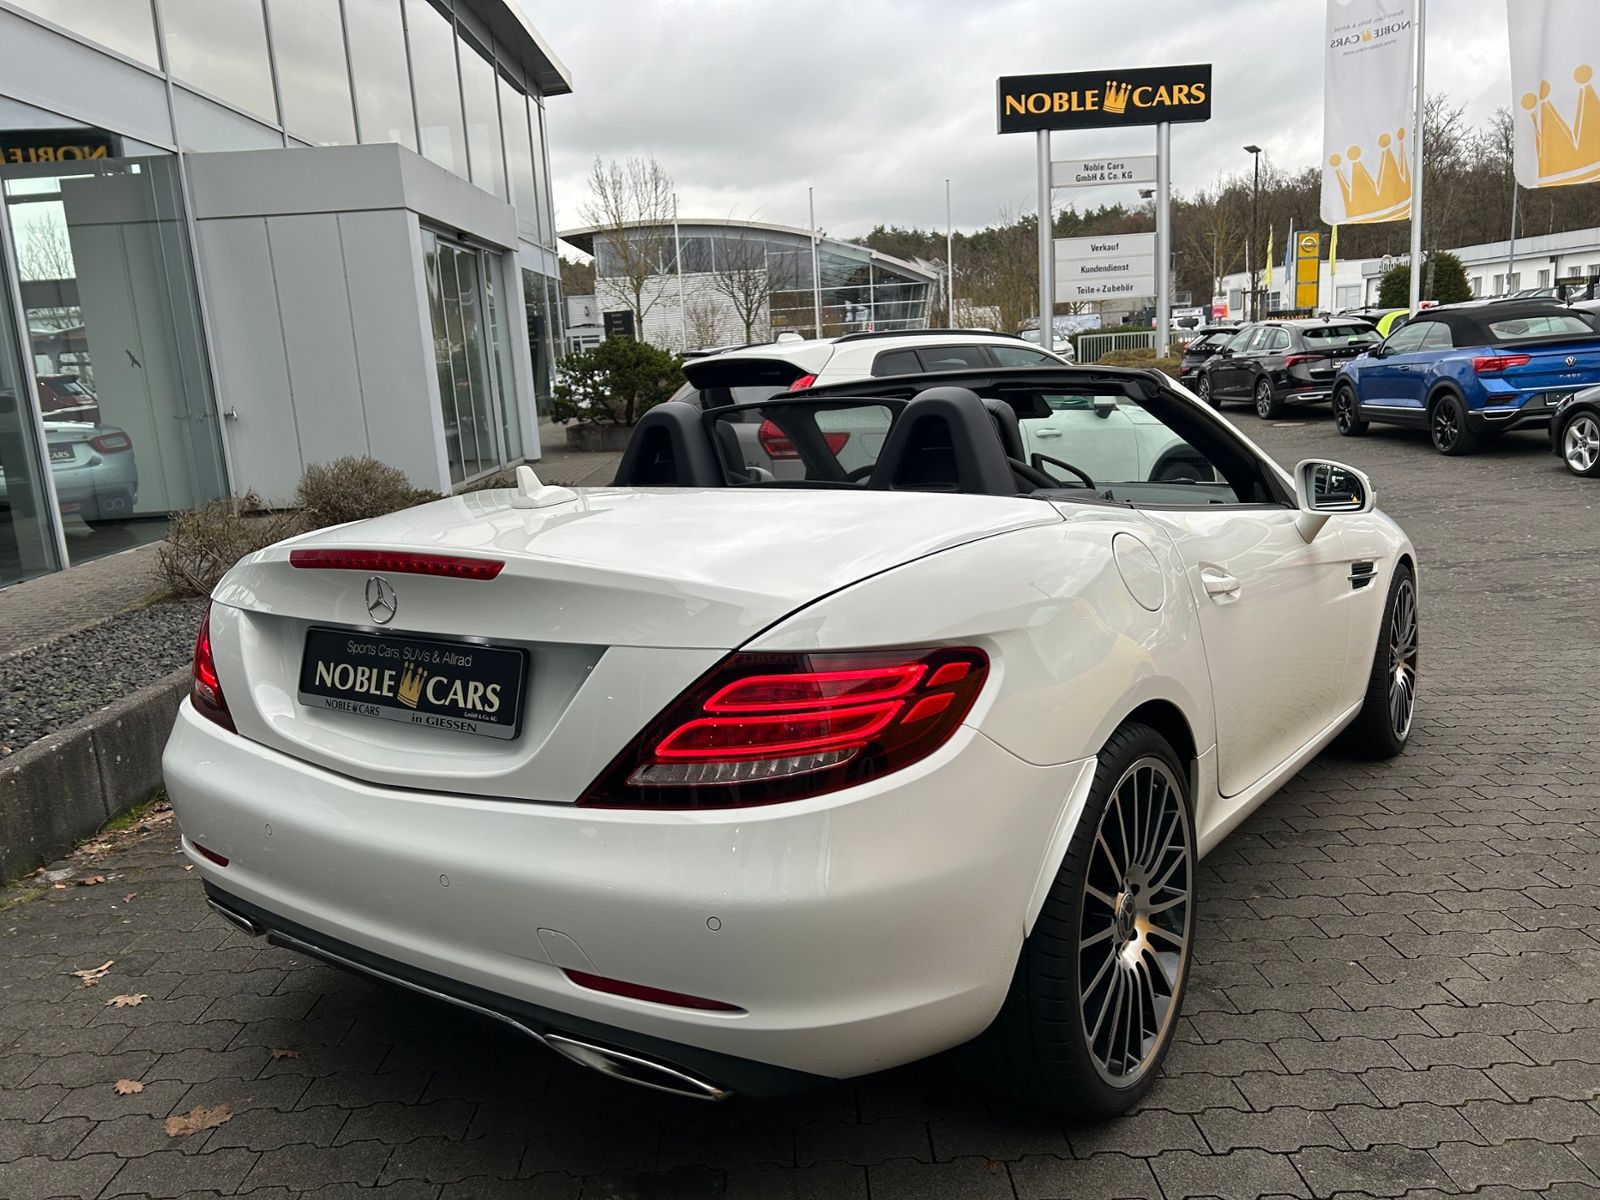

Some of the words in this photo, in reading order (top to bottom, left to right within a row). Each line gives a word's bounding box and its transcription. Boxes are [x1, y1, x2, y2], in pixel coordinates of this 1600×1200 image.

[1005, 89, 1099, 116] NOBLE
[1132, 83, 1206, 108] CARS
[1083, 162, 1105, 172] Noble
[1107, 161, 1125, 171] Cars
[1075, 173, 1098, 182] GmbH
[1099, 173, 1105, 181] &
[1107, 172, 1120, 181] Co.
[1121, 171, 1133, 180] KG
[1090, 243, 1119, 252] Verkauf
[1080, 263, 1130, 274] Kundendienst
[347, 640, 377, 656] Sports
[402, 646, 431, 662] SUVs
[432, 650, 440, 663] &
[441, 652, 473, 667] Allrad
[315, 660, 396, 698] NOBLE
[426, 676, 501, 713] CARS
[325, 698, 352, 712] NOBLE
[358, 704, 380, 717] CARS
[411, 713, 422, 724] in
[425, 716, 477, 733] GIESSEN
